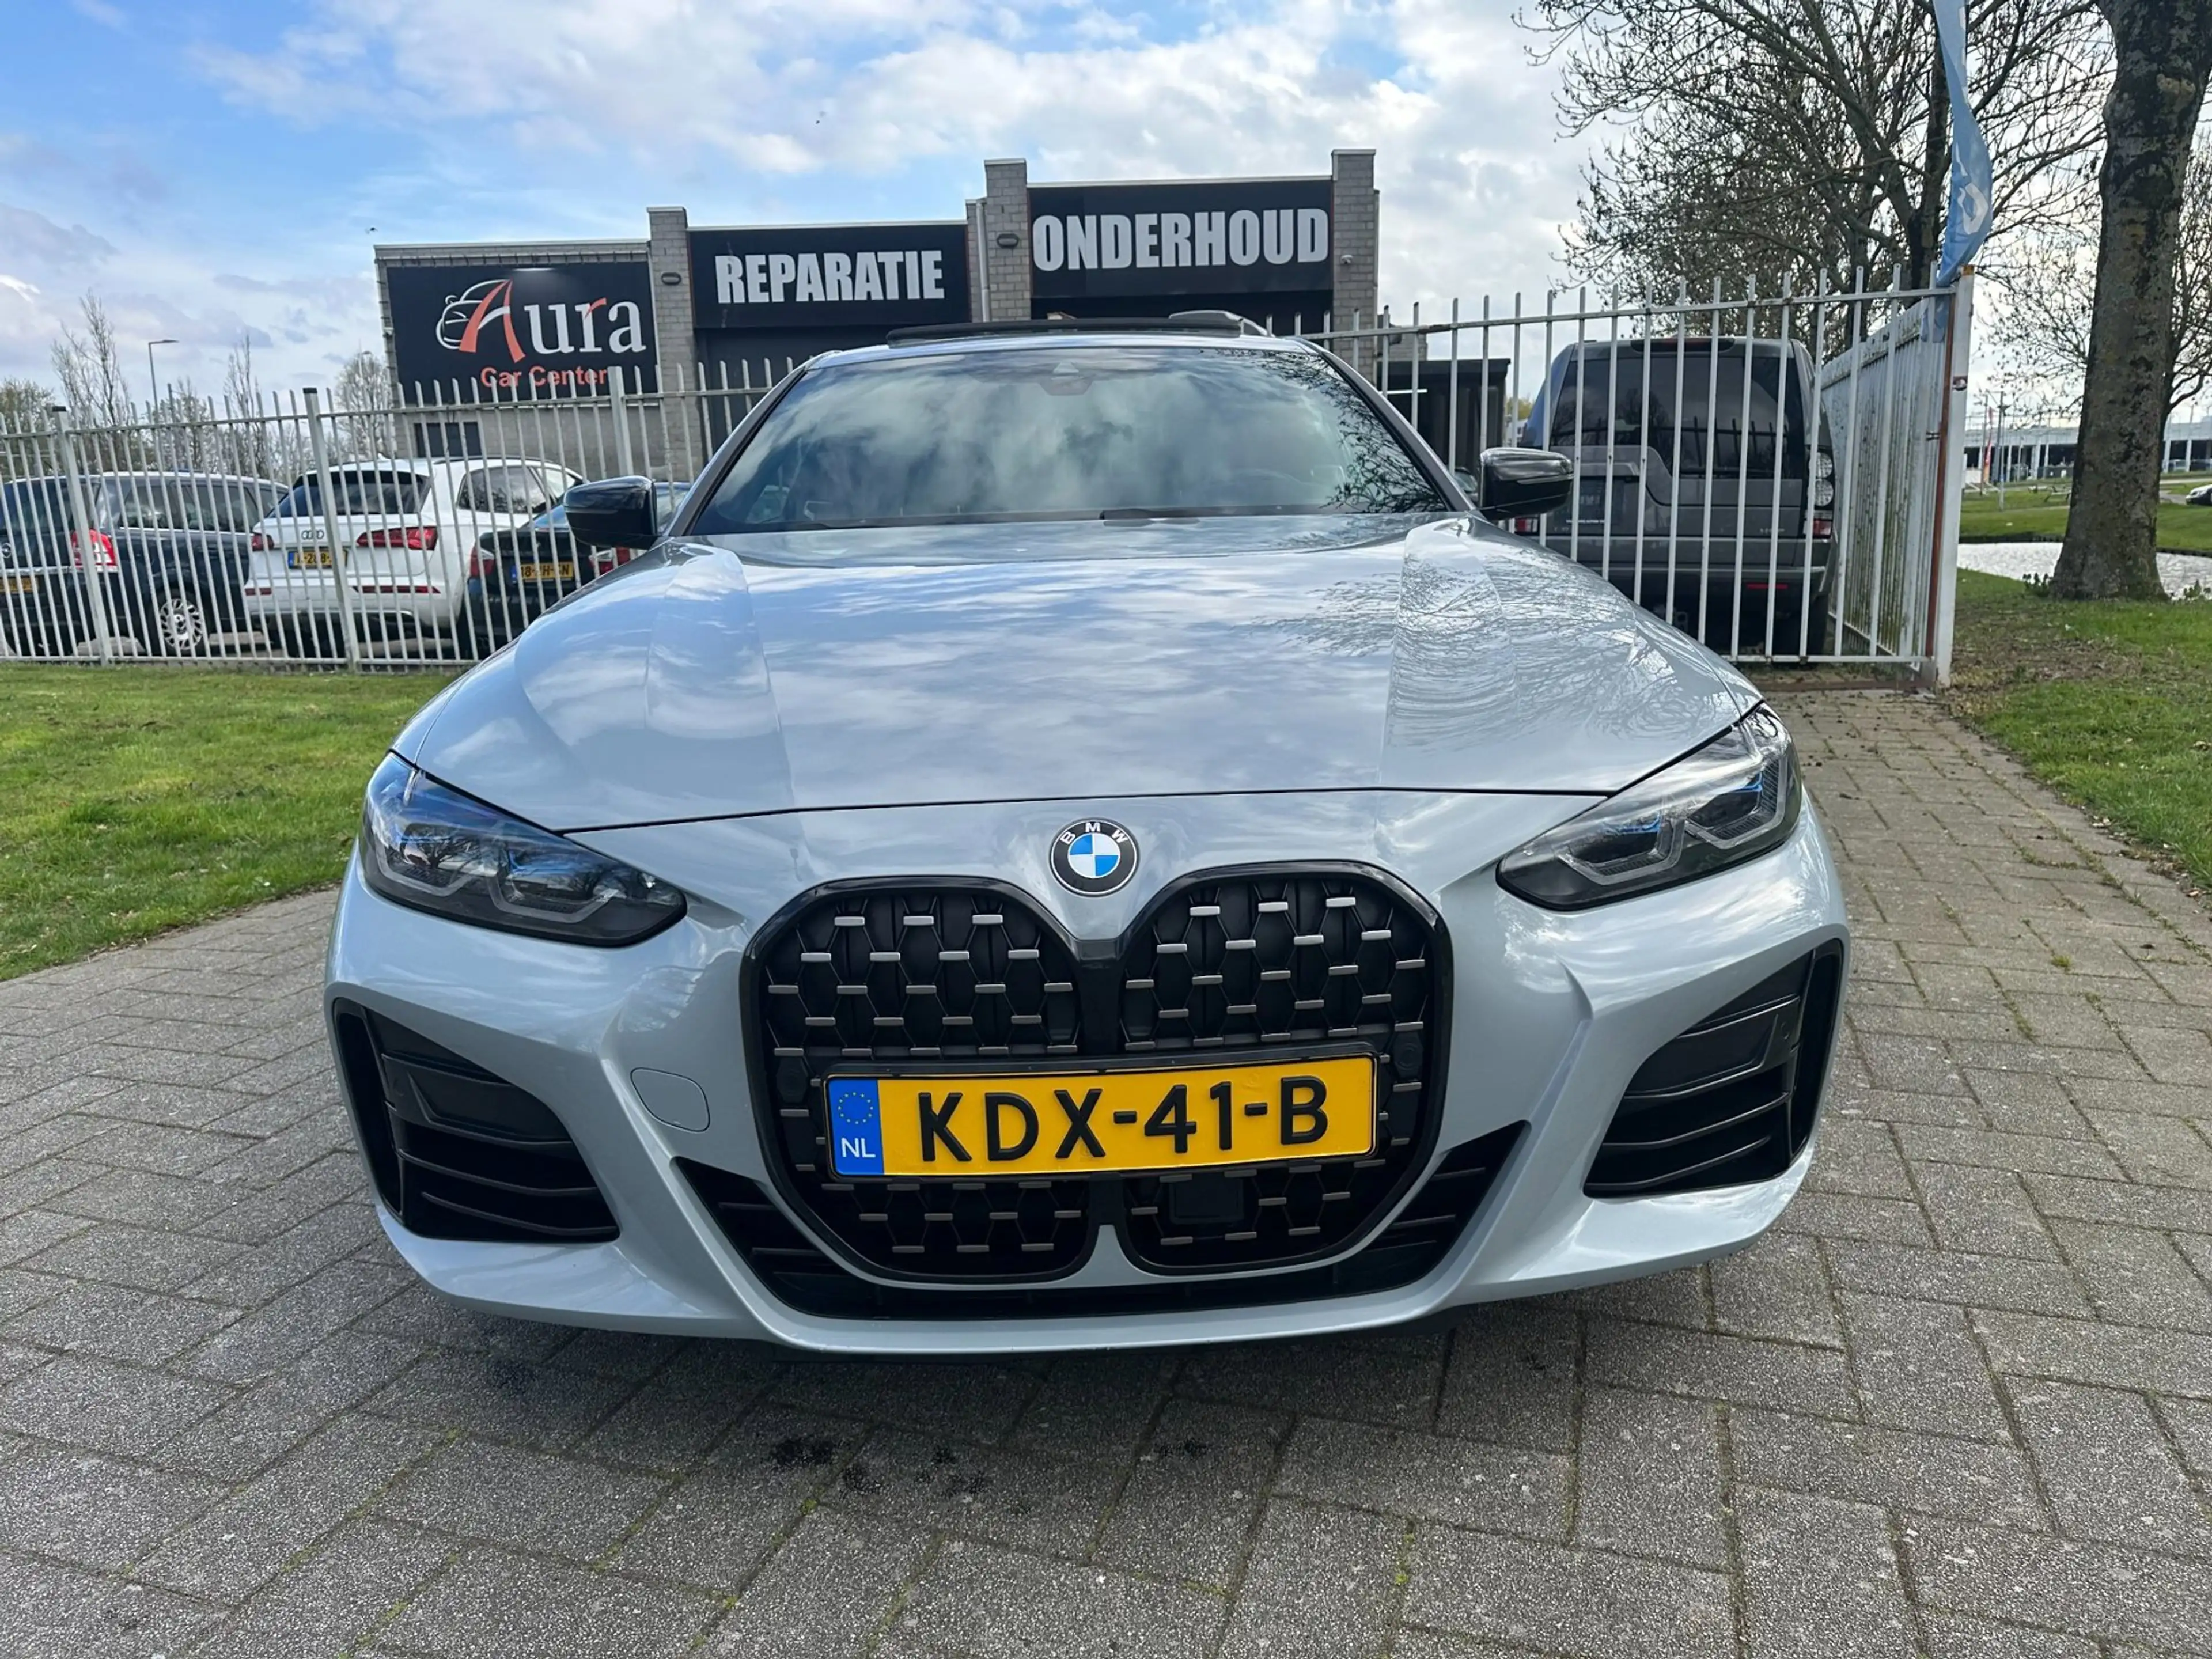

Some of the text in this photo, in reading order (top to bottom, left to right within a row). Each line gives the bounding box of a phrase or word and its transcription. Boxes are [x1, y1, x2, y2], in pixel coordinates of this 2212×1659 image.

[1033, 209, 1328, 271] ONDERHOUD
[715, 250, 945, 304] REPARATIE
[459, 279, 646, 363] Aura
[480, 365, 607, 388] Car Center
[1060, 822, 1128, 845] BMW
[918, 1077, 1329, 1162] KDX-41-B
[841, 1138, 876, 1158] NL
